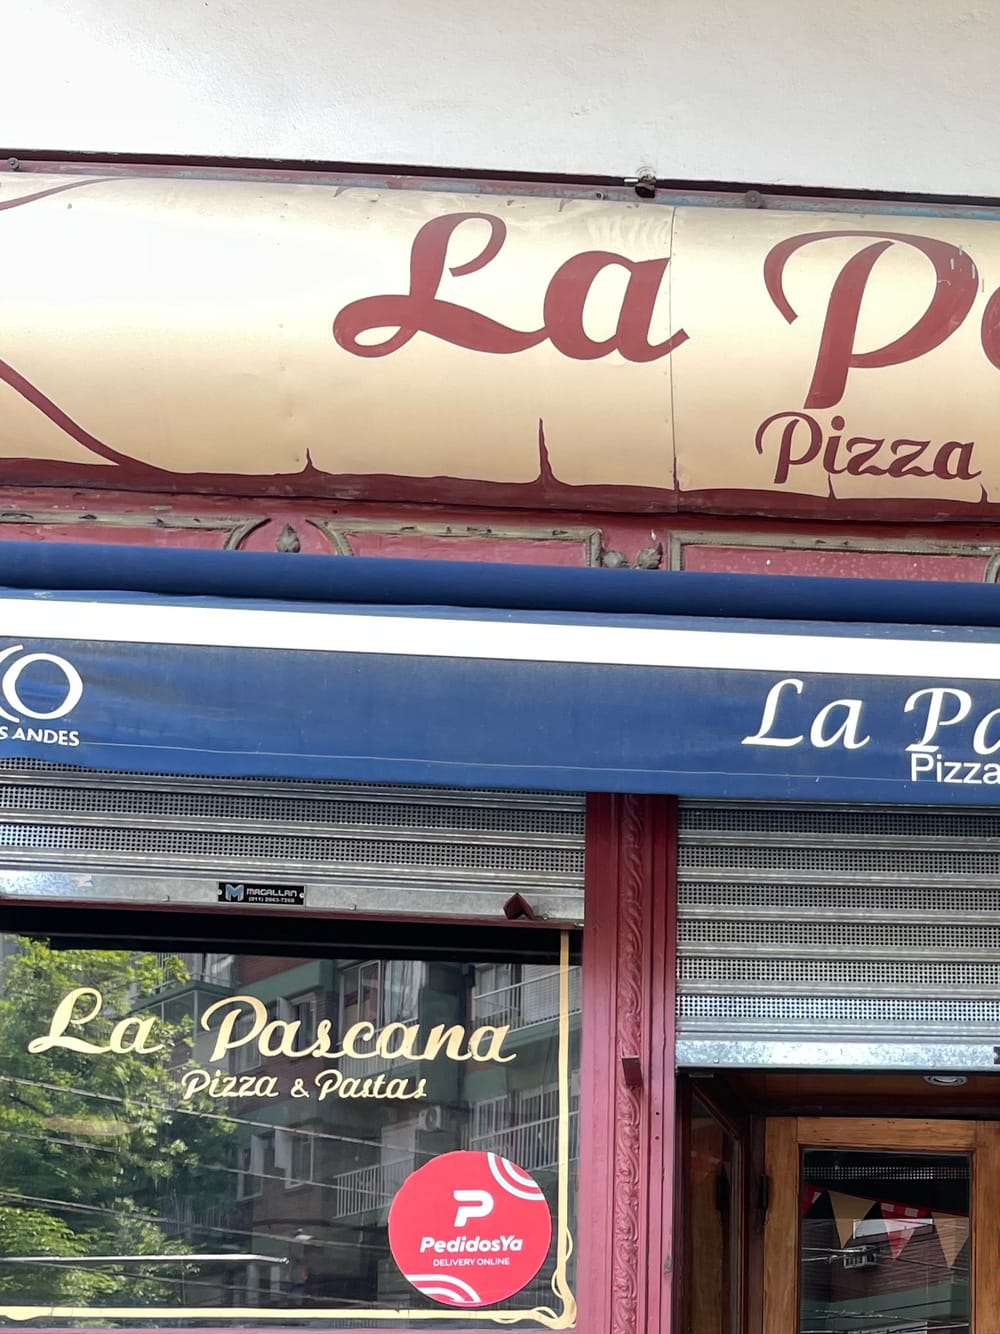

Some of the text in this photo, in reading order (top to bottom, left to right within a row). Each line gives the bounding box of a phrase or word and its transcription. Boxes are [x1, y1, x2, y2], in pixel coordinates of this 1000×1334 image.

[332, 212, 690, 363] La
[755, 411, 982, 483] Pizza
[740, 678, 870, 750] La
[12, 728, 80, 746] ANDES
[246, 888, 298, 897] MAGALLAN
[27, 987, 518, 1063] La Pascana
[181, 1069, 427, 1102] Pizza & Pastas
[420, 1235, 523, 1253] PedidosYa
[433, 1257, 510, 1267] DELIVERY ONLINE
